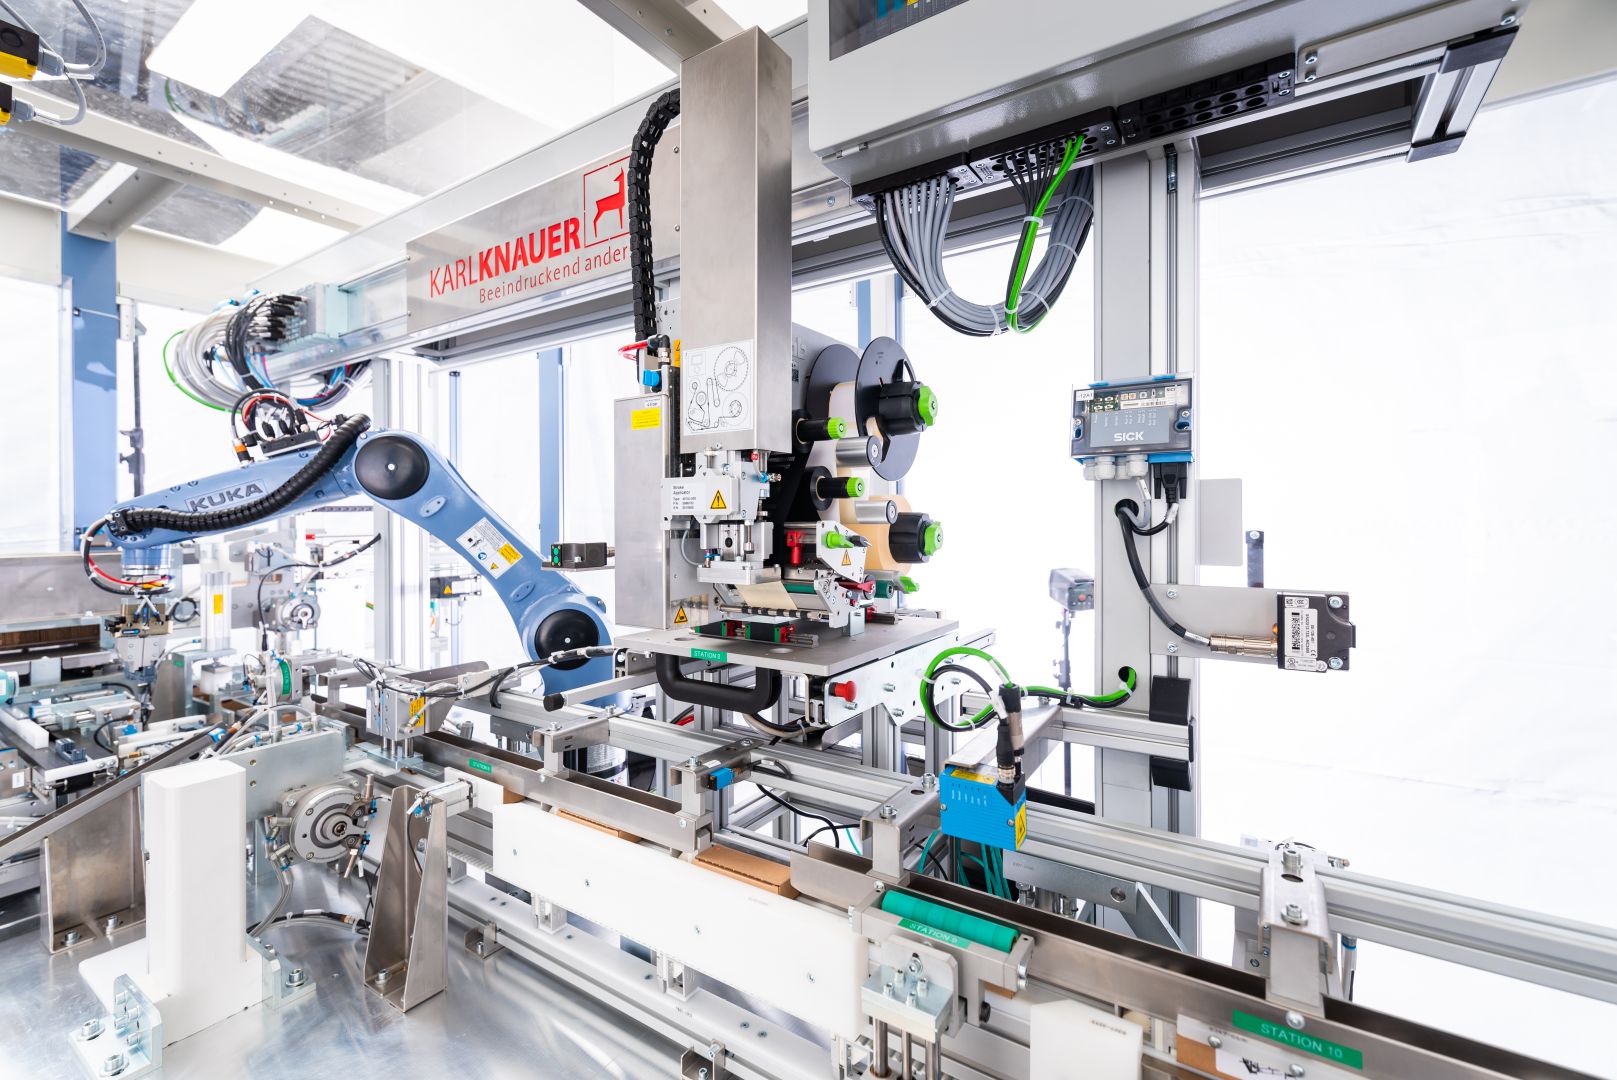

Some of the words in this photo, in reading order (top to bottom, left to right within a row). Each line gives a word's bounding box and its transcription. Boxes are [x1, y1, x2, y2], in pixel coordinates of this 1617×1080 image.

[430, 217, 581, 298] KARLKNAUER
[479, 257, 581, 303] Beeindruckend
[584, 245, 629, 271] ander
[1114, 431, 1144, 442] SICK
[190, 483, 263, 512] KUKA
[694, 650, 717, 659] STATION
[910, 923, 951, 941] STATION
[1260, 1023, 1323, 1053] STATION
[1328, 1047, 1344, 1060] 10
